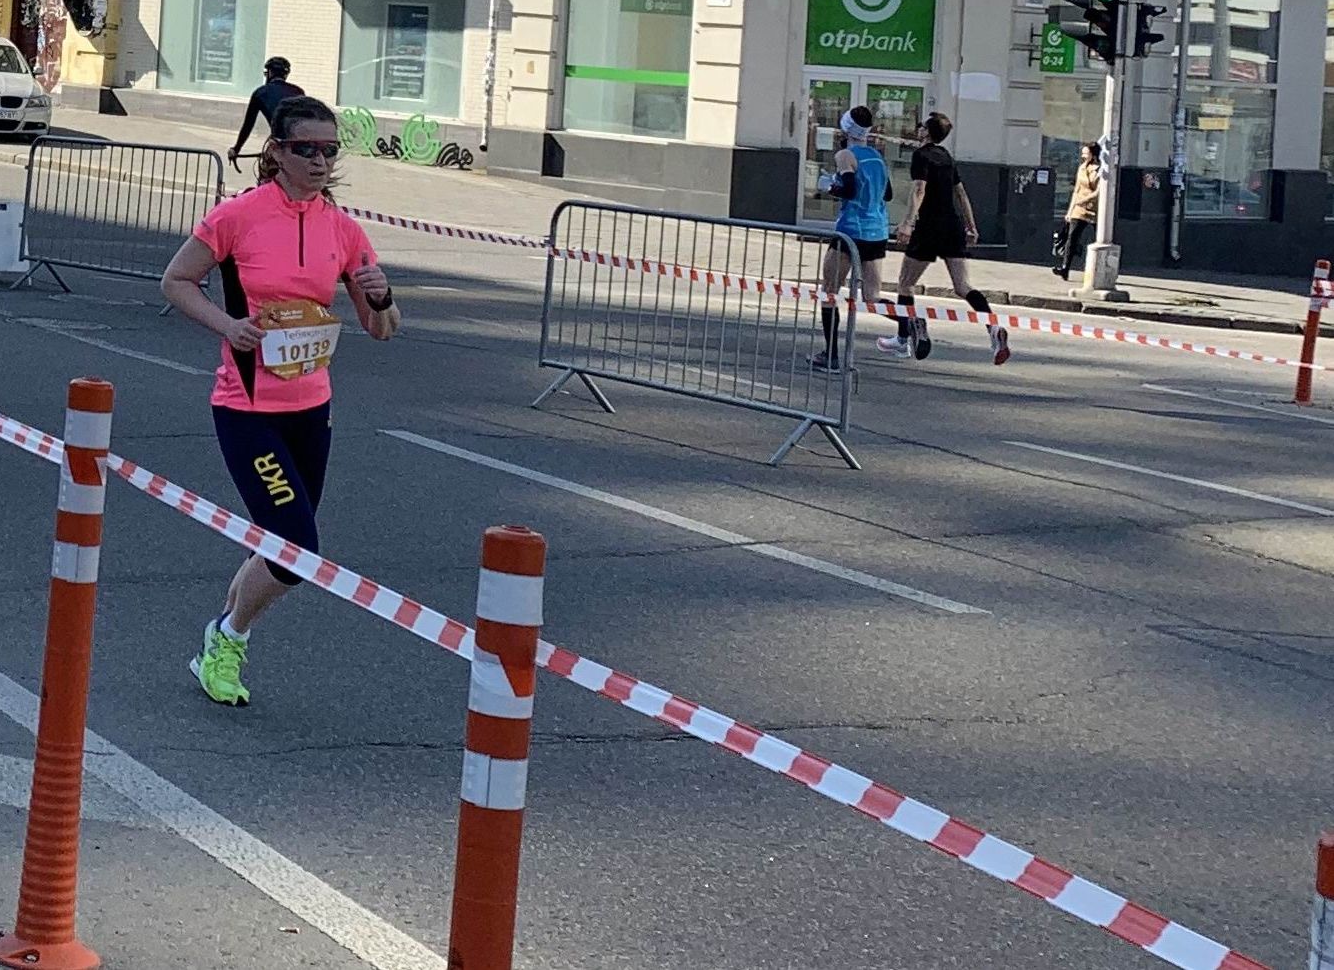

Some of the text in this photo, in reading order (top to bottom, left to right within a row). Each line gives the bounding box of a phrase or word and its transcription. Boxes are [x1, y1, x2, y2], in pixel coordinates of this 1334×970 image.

[820, 29, 918, 54] otpbank
[1042, 56, 1064, 66] 0-24
[880, 89, 908, 100] 0-24
[277, 339, 331, 363] 10139
[254, 451, 295, 506] UKR
